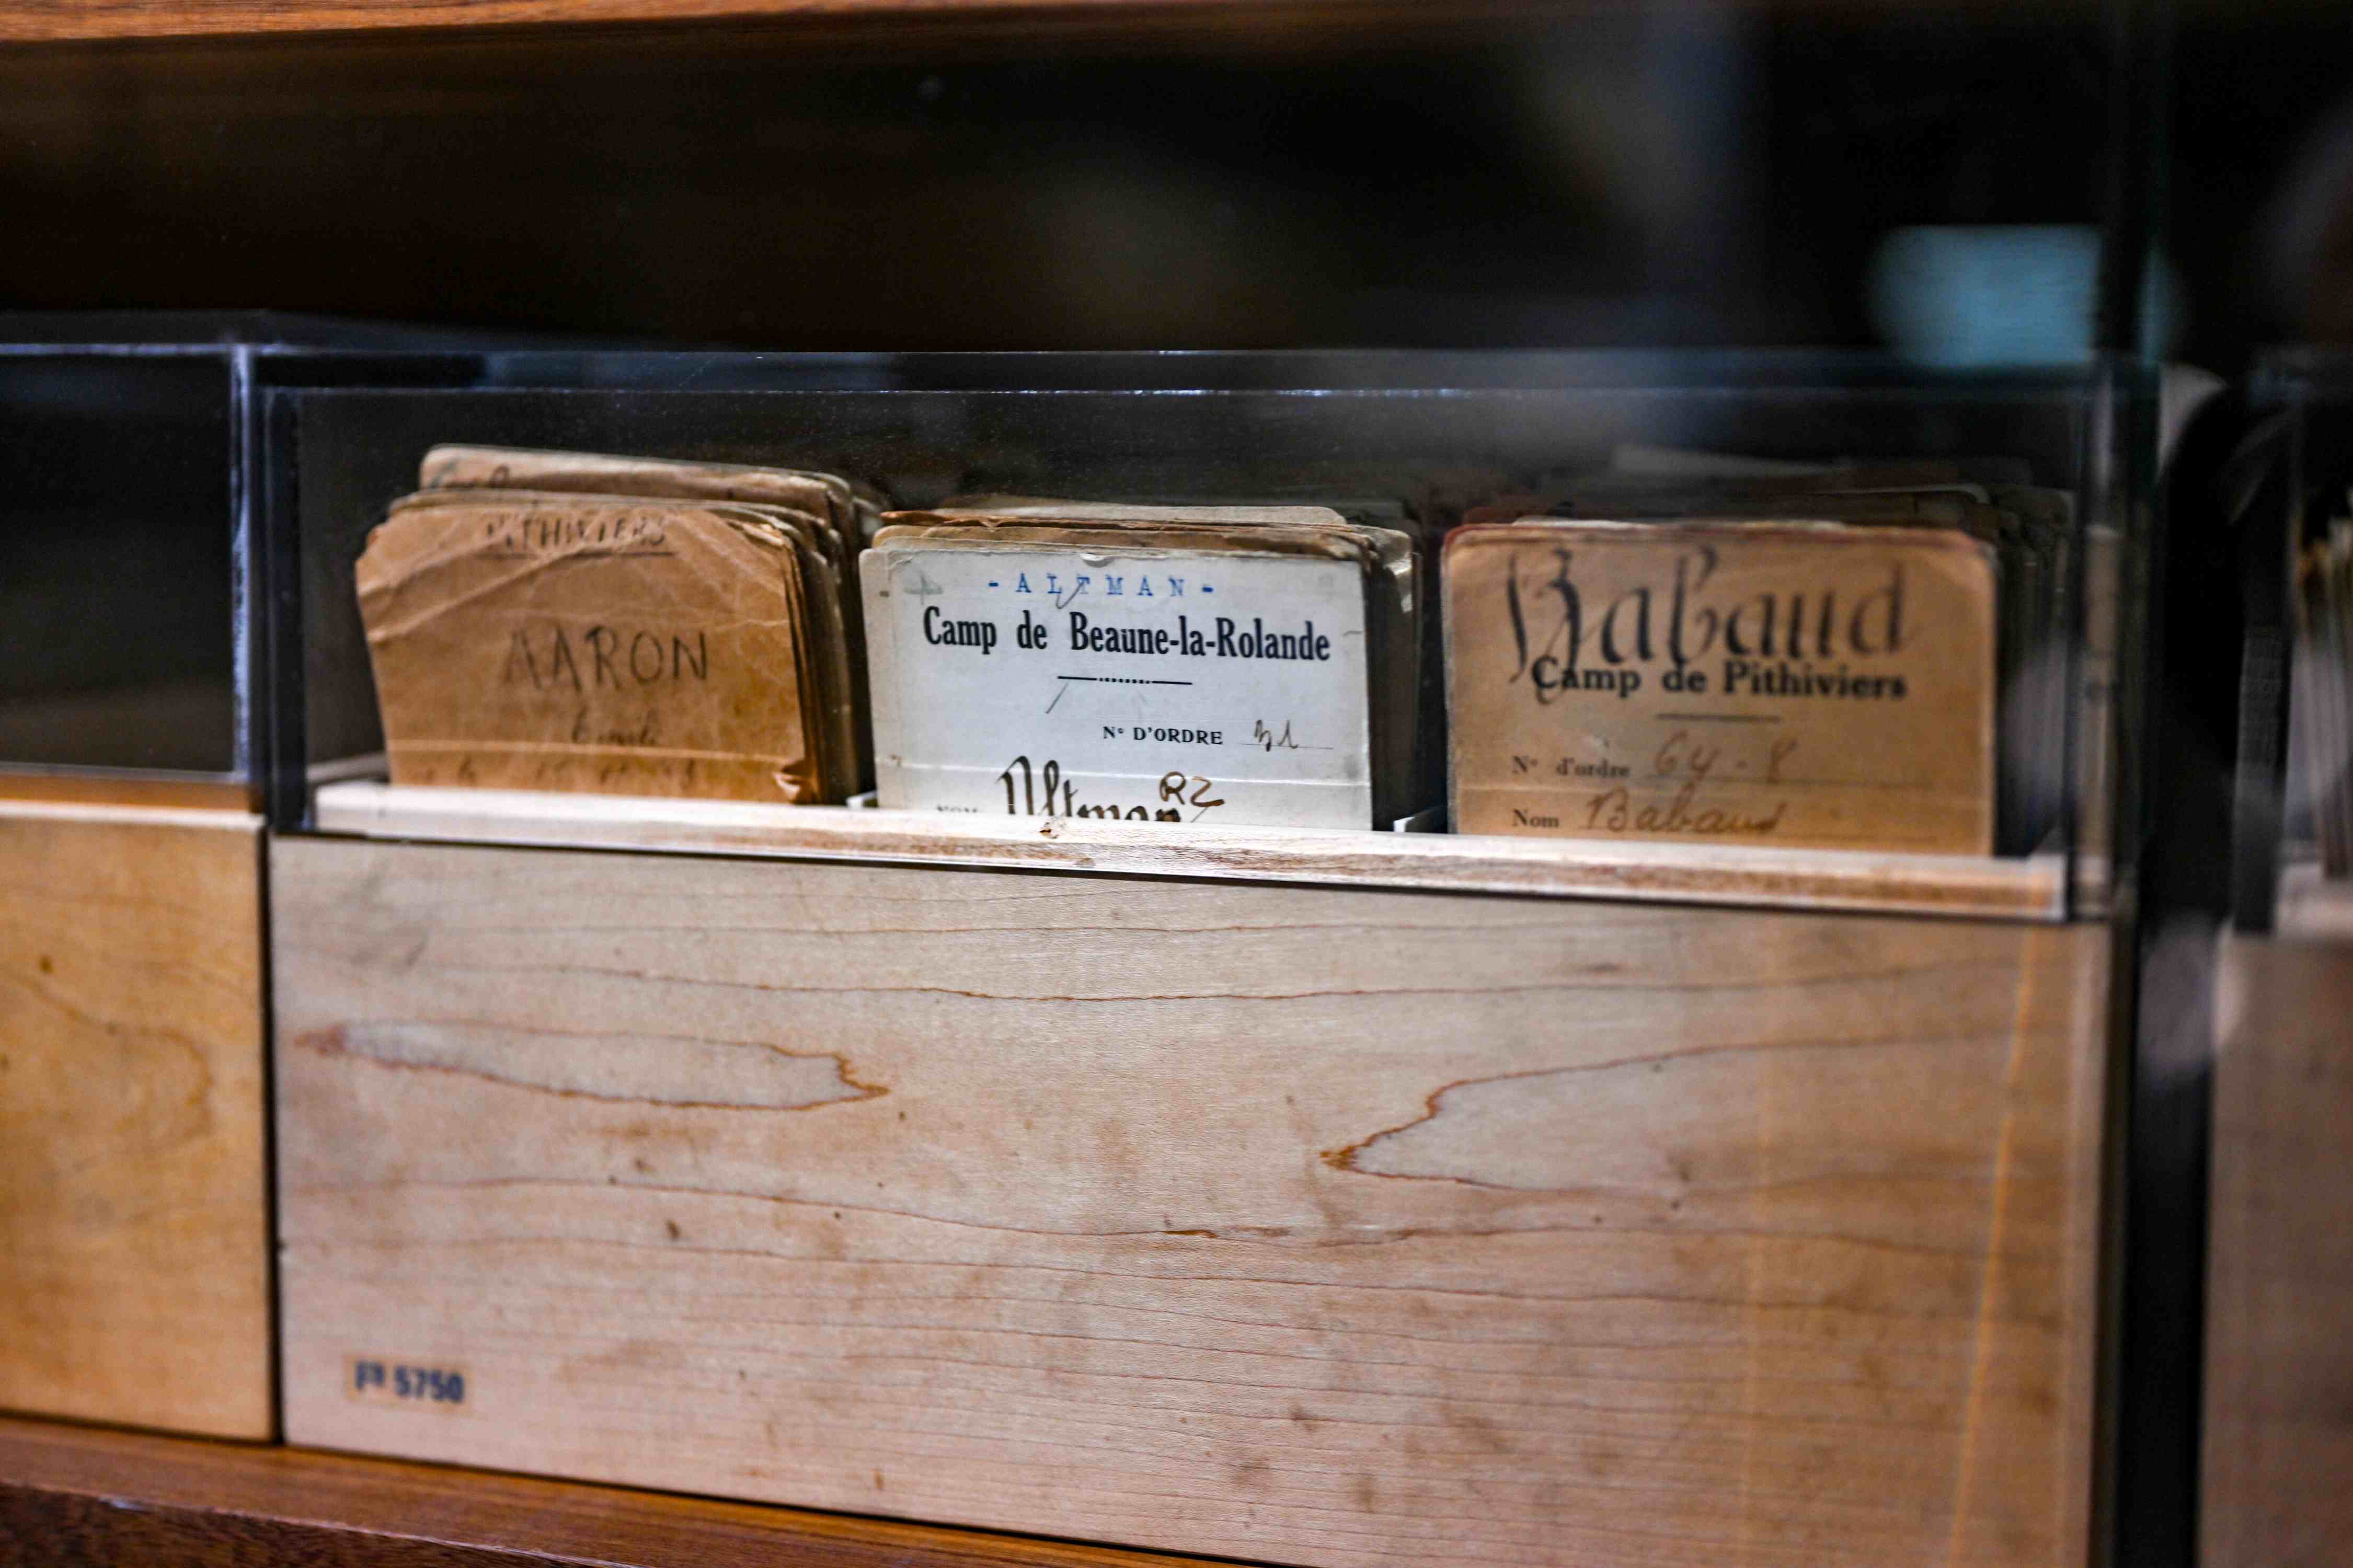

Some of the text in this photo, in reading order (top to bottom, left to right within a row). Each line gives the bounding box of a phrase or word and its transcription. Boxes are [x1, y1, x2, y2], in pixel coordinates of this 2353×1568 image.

[924, 605, 1330, 661] Camp de Beaune-la-Rolande
[502, 624, 707, 693] AARON
[1531, 655, 1908, 699] Camp de Pithiviers
[1132, 726, 1224, 746] D'ORDRE
[1556, 756, 1631, 779] d'ordre
[1512, 808, 1559, 828] Nom
[394, 1364, 465, 1404] 5750
